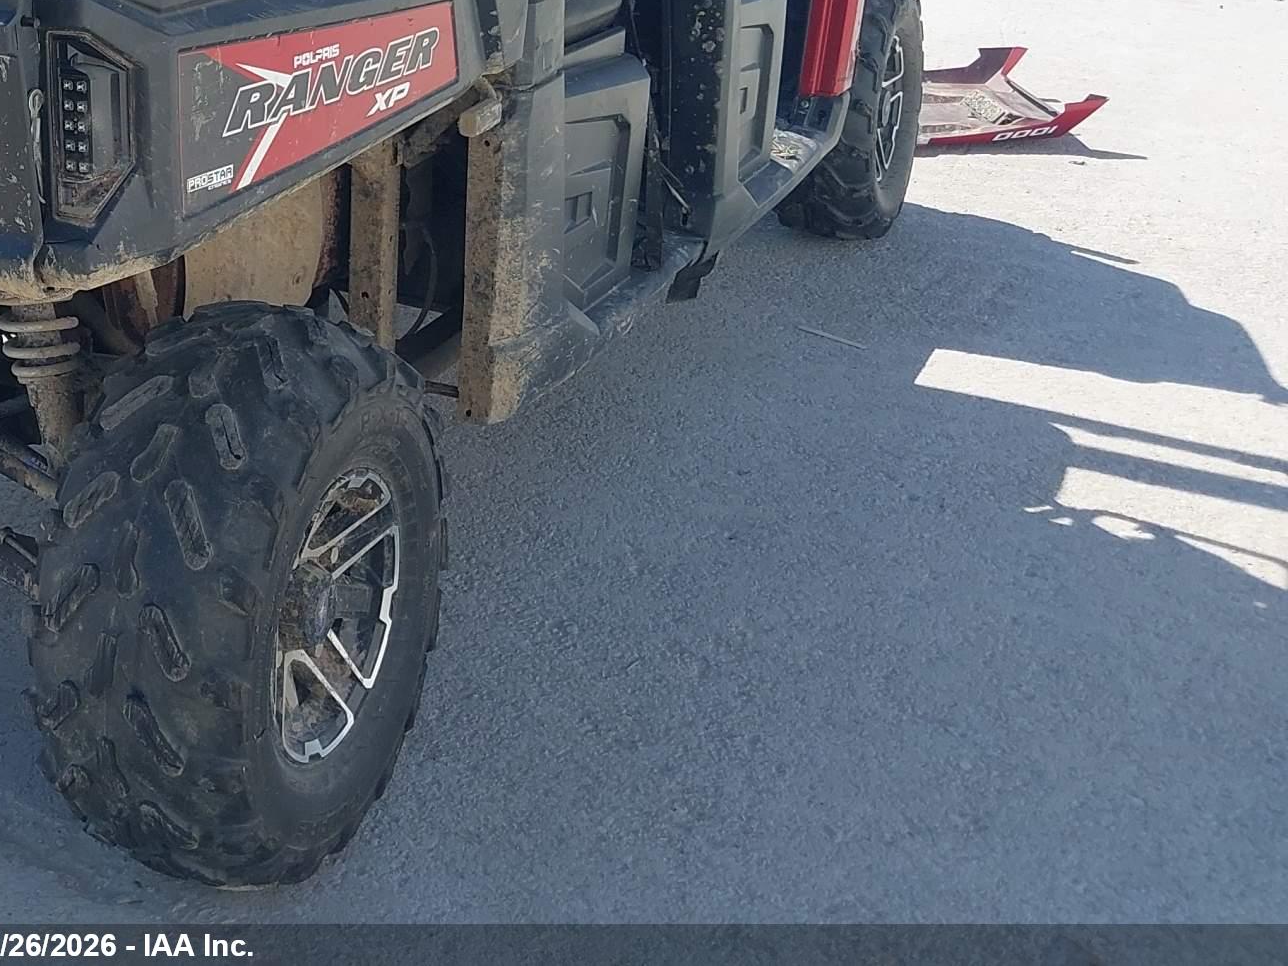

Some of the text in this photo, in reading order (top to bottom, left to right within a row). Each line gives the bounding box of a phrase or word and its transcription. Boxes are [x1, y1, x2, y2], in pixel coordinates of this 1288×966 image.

[293, 44, 340, 68] POLARIS
[222, 27, 440, 137] RANGER
[366, 82, 410, 117] XP
[187, 164, 233, 192] PROSTAR
